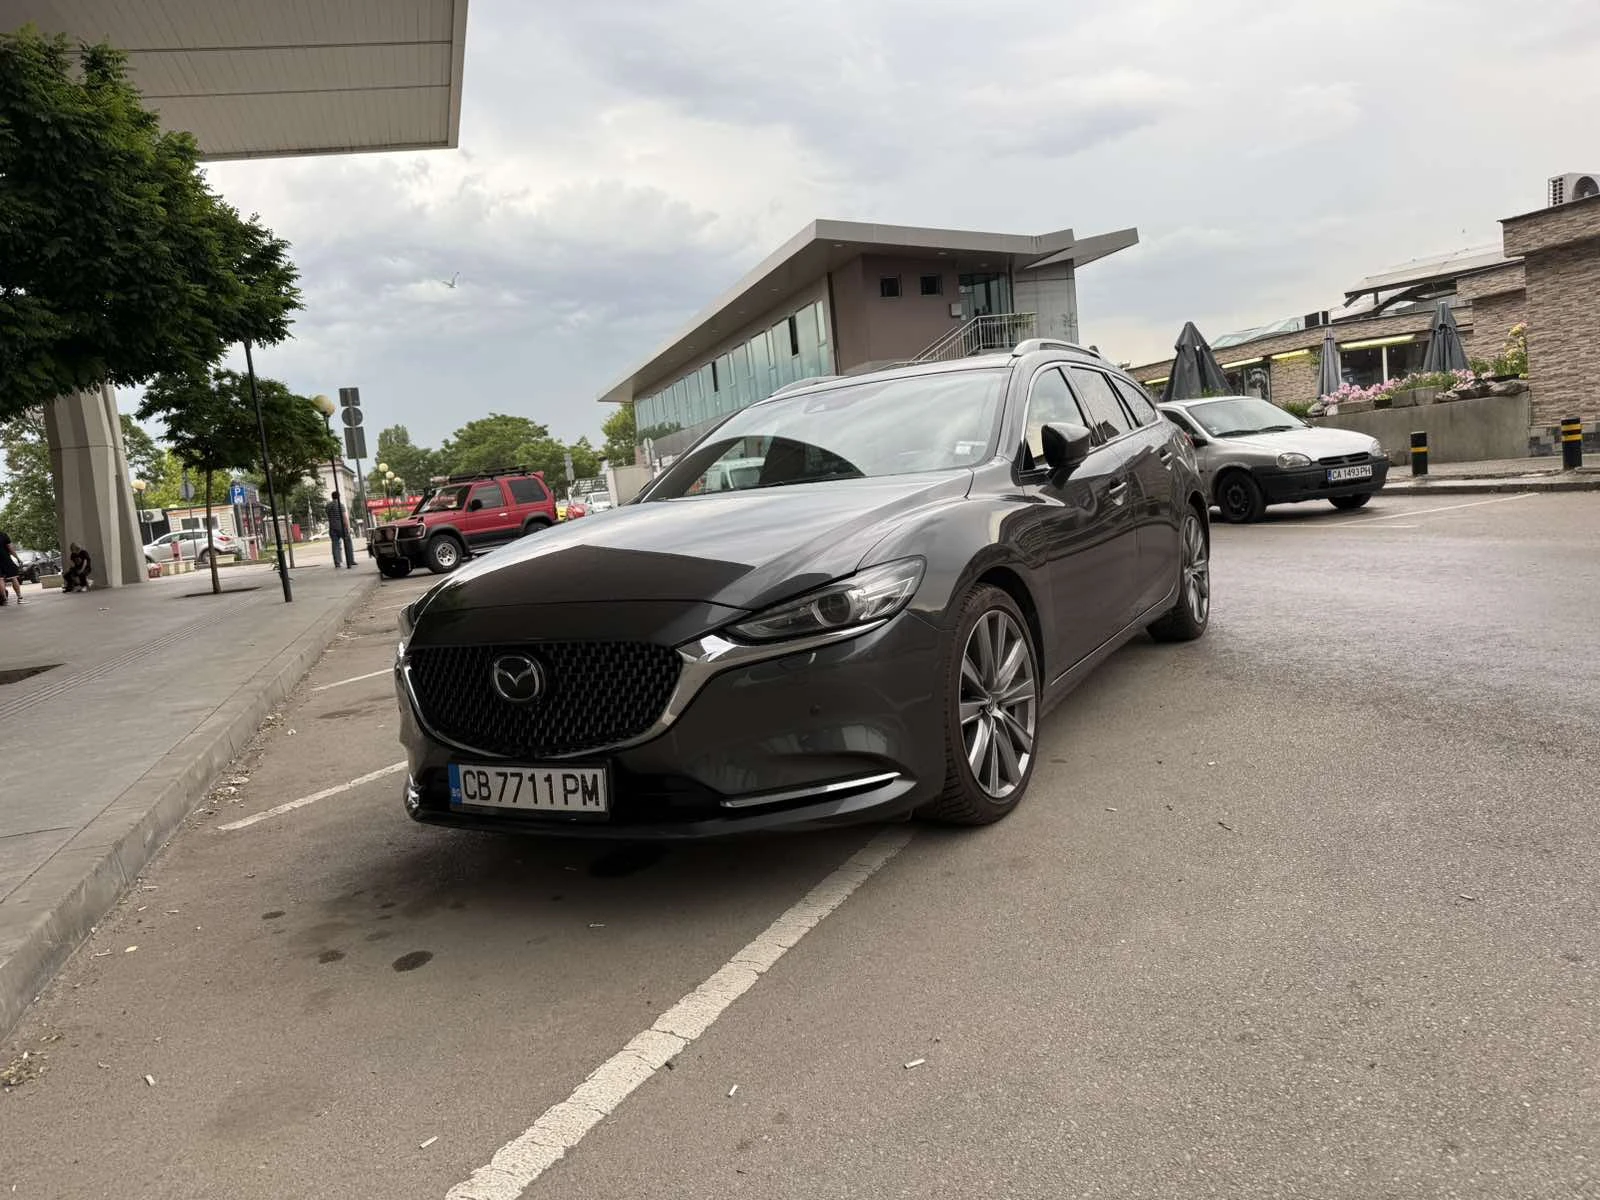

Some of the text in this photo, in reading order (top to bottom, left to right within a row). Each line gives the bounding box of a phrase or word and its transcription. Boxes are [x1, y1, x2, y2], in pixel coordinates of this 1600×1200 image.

[463, 770, 600, 806] CB 7711 PM
